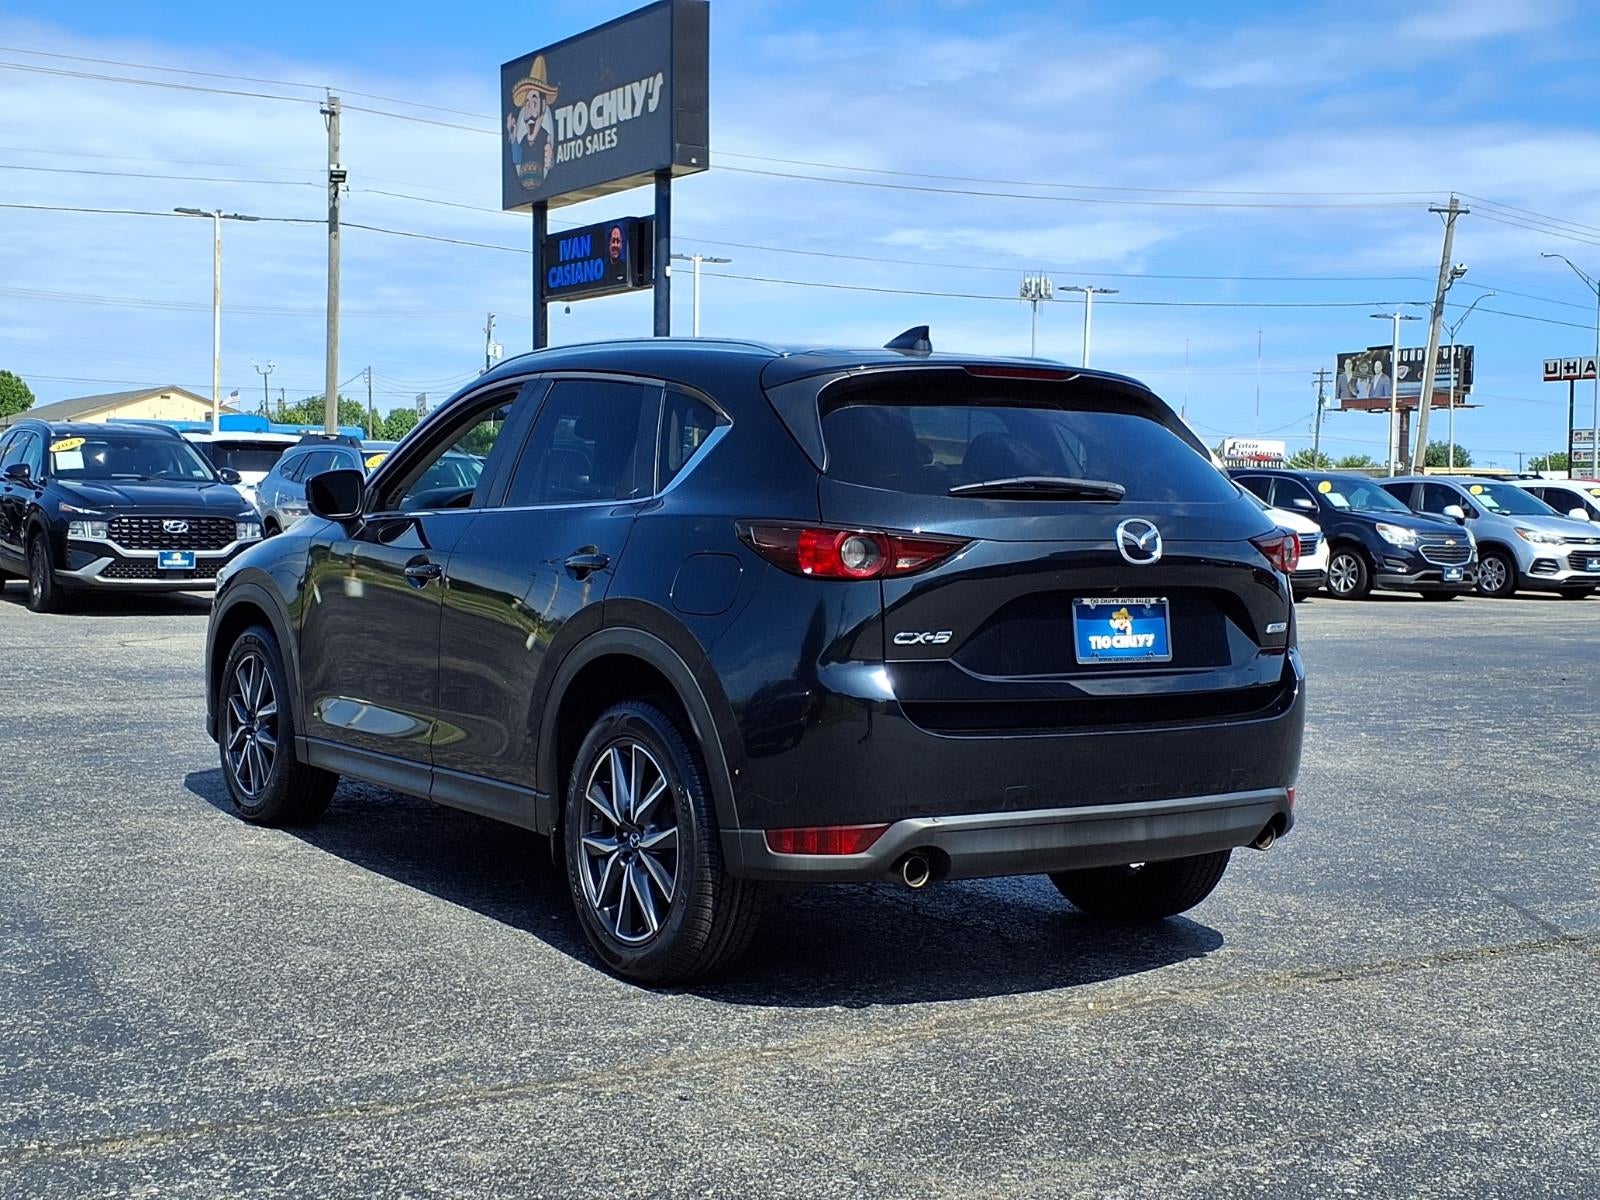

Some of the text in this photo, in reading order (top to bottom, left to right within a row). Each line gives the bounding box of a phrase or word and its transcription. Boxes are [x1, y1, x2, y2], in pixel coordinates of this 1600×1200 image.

[555, 72, 664, 141] TIO CHUY'S
[556, 127, 618, 163] AUTO SALES
[559, 233, 592, 262] IVAN
[548, 257, 604, 288] CASIANO
[1231, 441, 1259, 449] Color
[893, 631, 953, 645] CX-5
[1088, 633, 1155, 650] TIO CHUY'S
